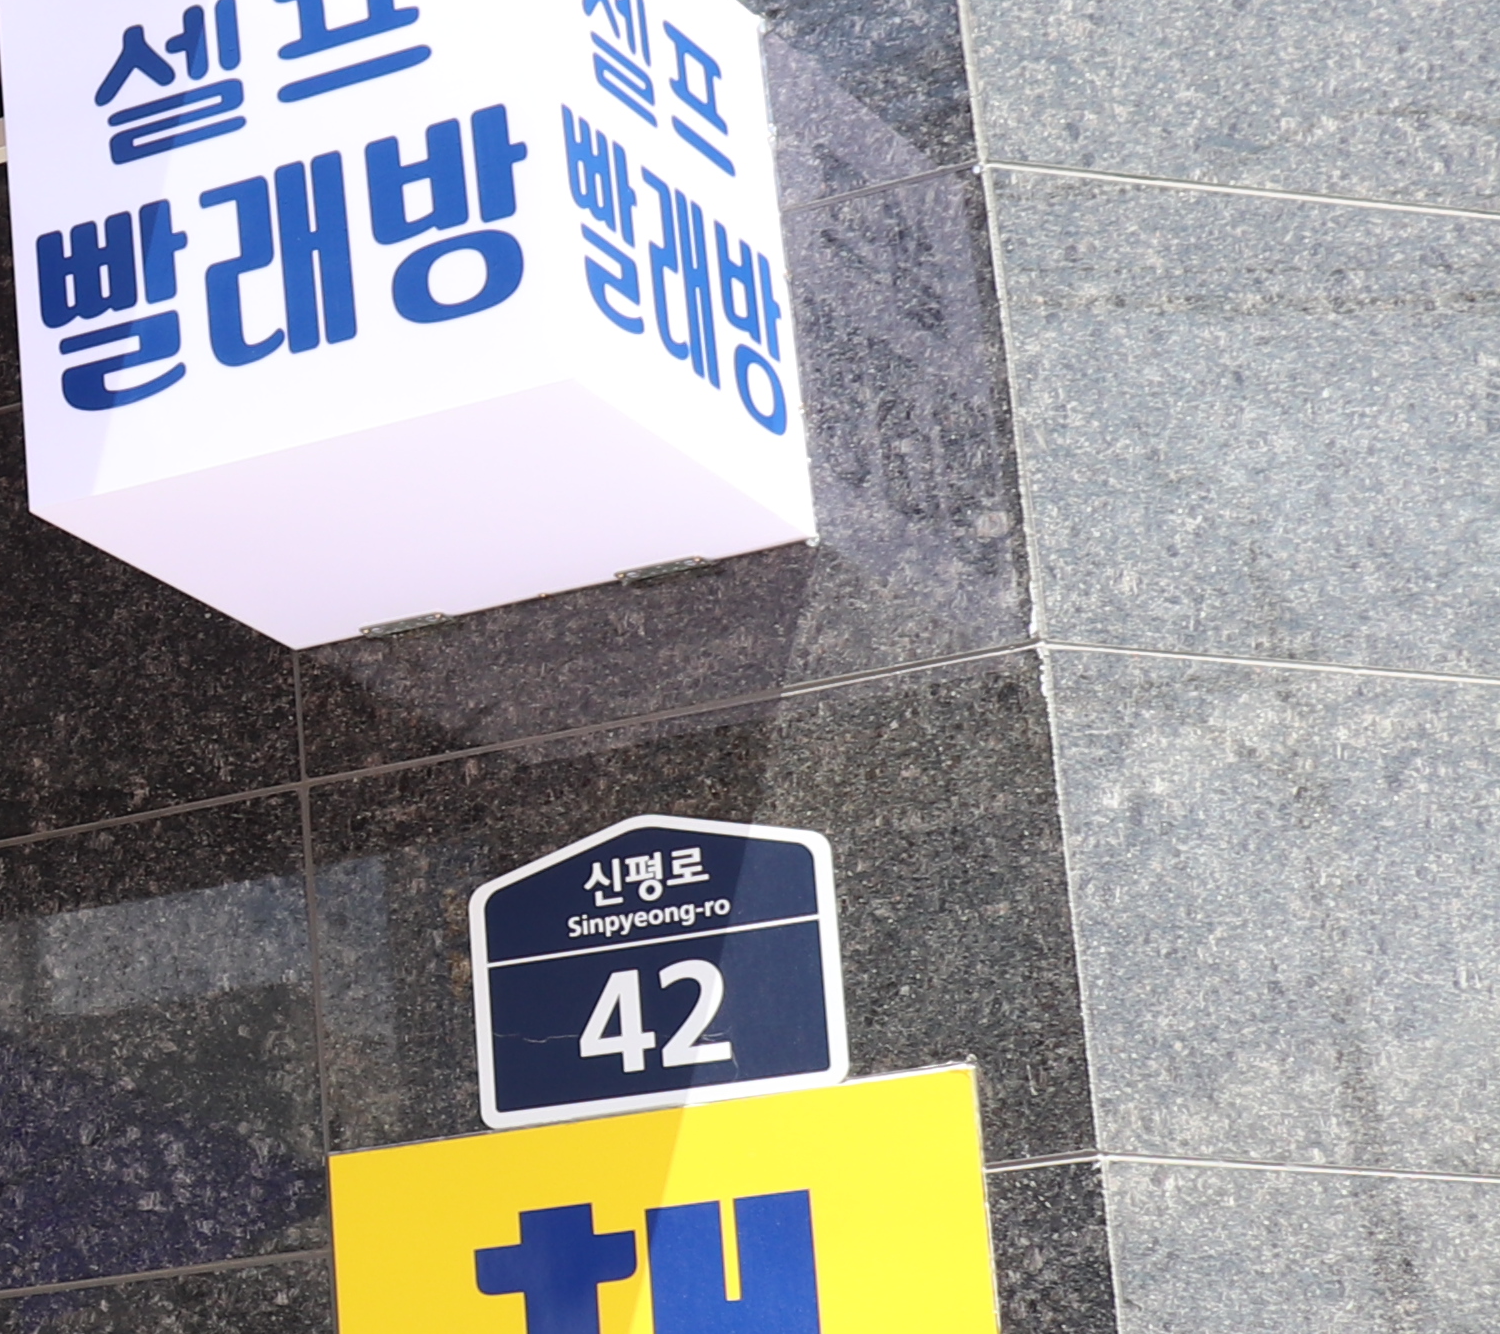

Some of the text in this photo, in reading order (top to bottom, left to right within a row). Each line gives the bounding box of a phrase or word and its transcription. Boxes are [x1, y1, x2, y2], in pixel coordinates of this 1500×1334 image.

[35, 101, 529, 413] 빨래방
[560, 101, 790, 437] 빨래방
[566, 896, 733, 938] Sinpyeong-ro
[582, 846, 711, 907] 신평로
[578, 958, 734, 1074] 42
